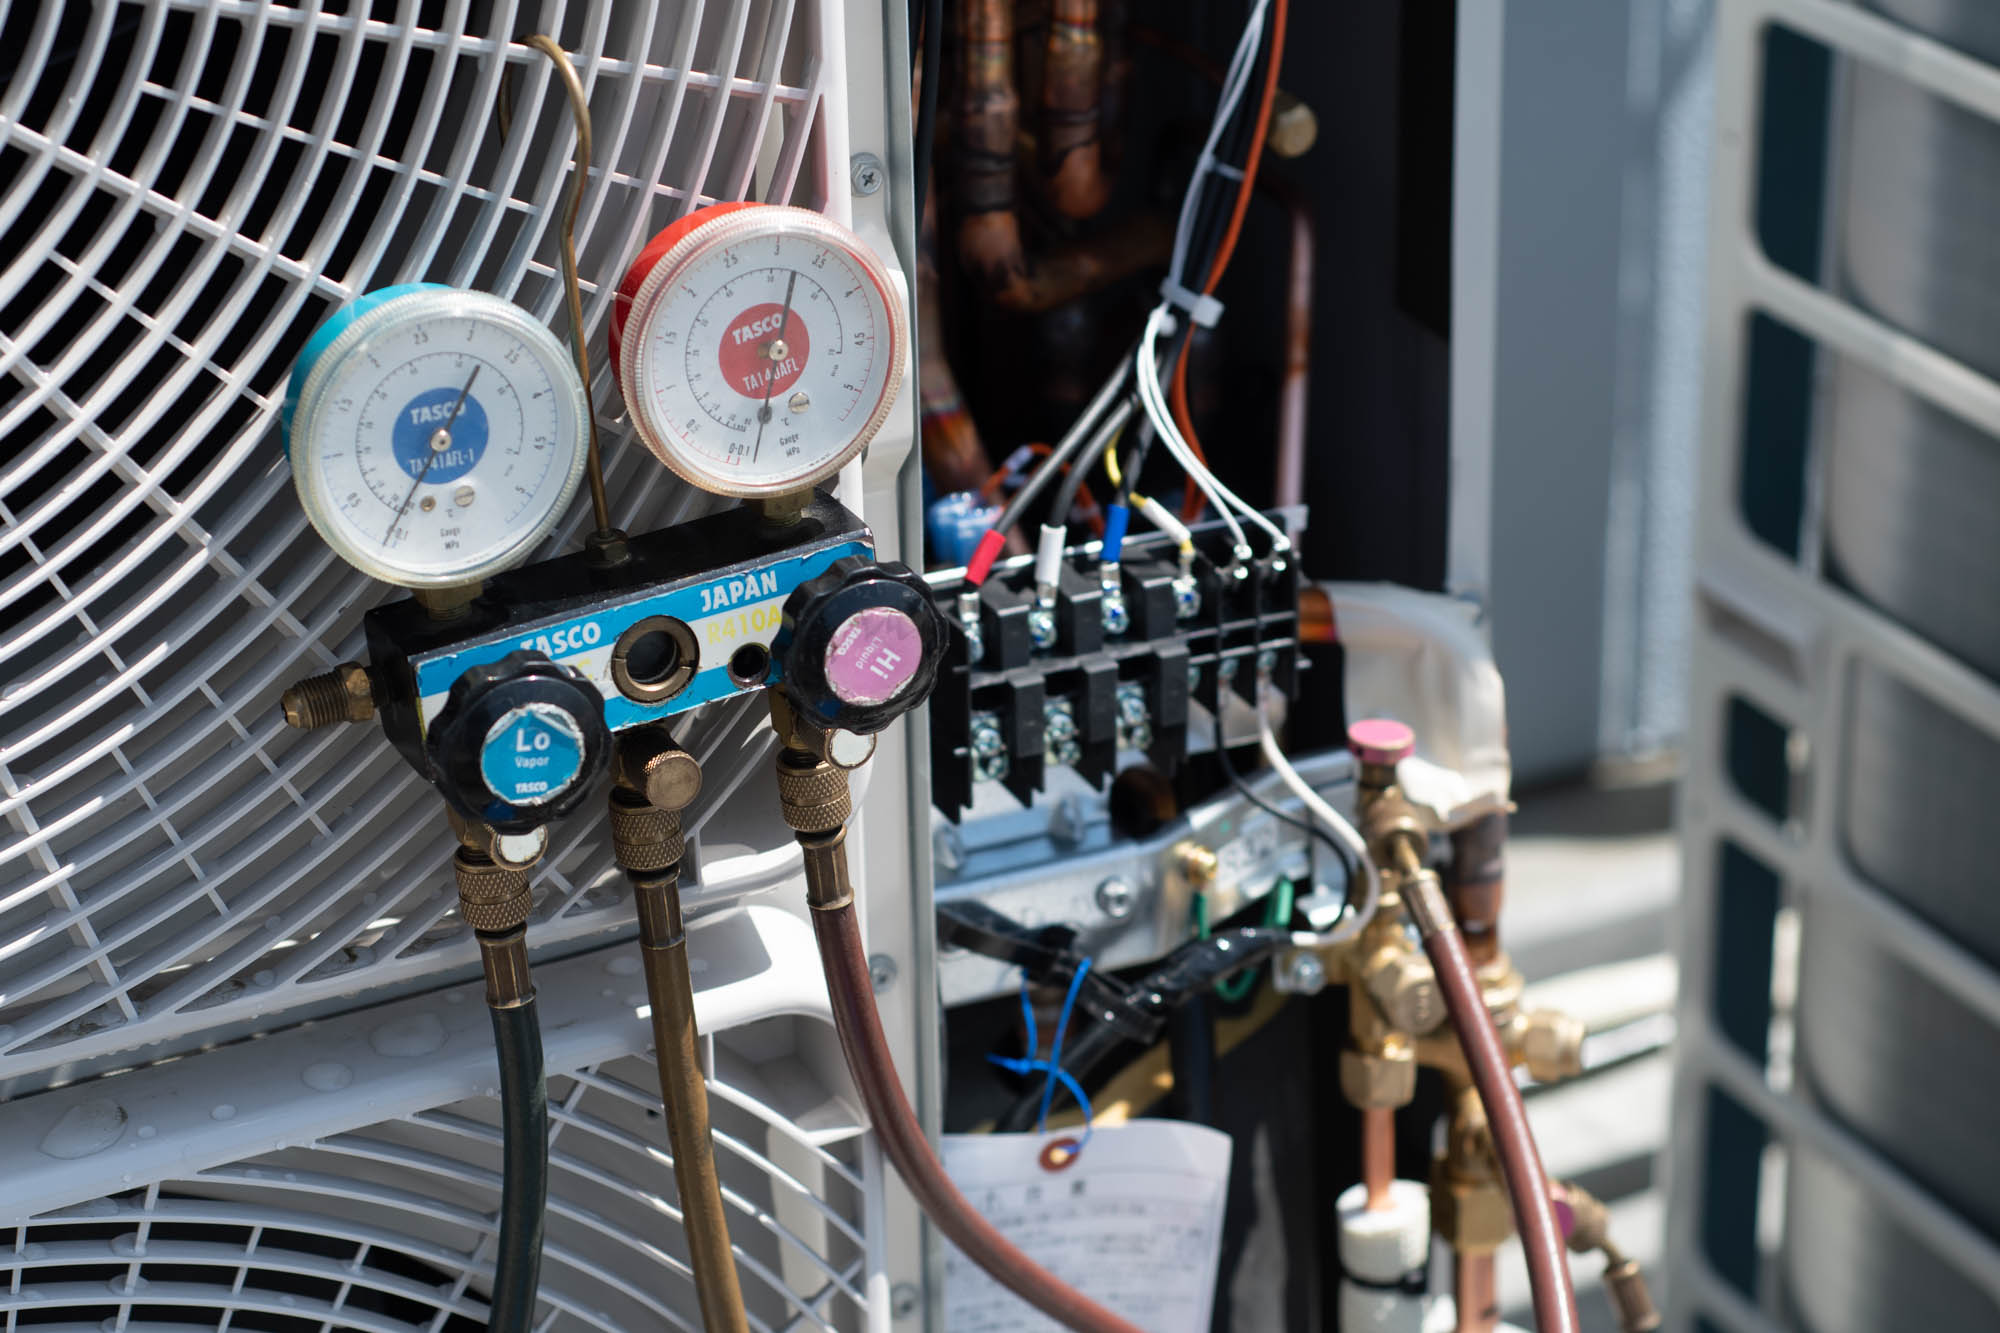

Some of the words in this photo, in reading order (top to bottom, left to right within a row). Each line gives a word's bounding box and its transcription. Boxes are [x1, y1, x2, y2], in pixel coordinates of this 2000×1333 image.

[732, 313, 782, 345] TASCO
[843, 383, 854, 391] 5
[410, 400, 467, 425] TASCO
[779, 433, 800, 446] Gauge
[786, 446, 801, 457] MPa
[700, 570, 778, 613] JAPAN
[520, 621, 602, 655] TASCO
[706, 604, 782, 646] R410A
[836, 627, 862, 655] TASCO
[855, 637, 881, 670] Liquid
[870, 647, 901, 680] Hi
[516, 728, 551, 752] Lo
[515, 756, 550, 769] Vapor
[515, 781, 549, 794] TASCO
